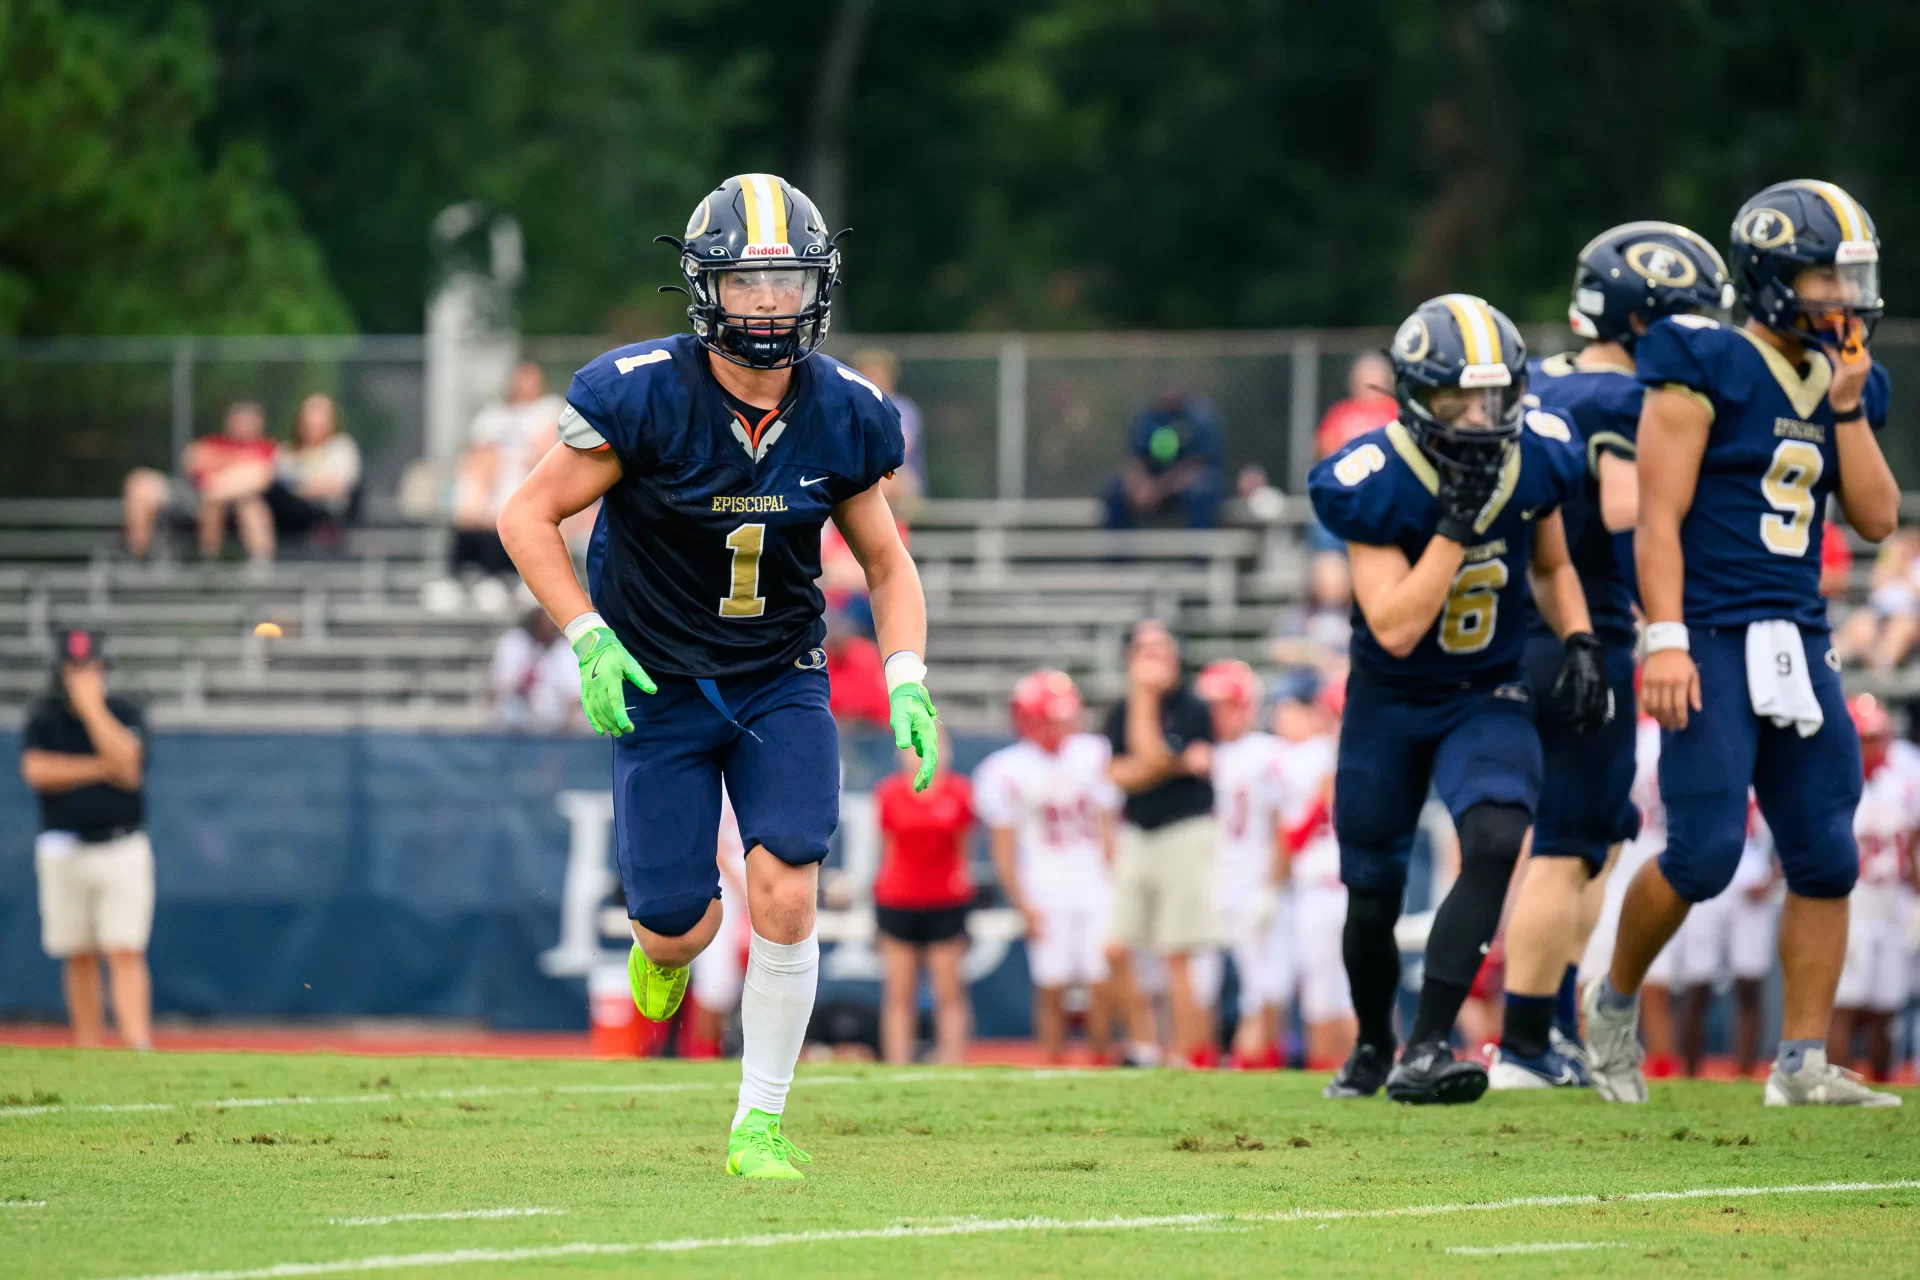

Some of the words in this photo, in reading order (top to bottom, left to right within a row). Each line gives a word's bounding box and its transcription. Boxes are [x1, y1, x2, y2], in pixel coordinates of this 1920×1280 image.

[748, 246, 789, 256] Riddell
[614, 349, 672, 375] 1
[836, 366, 883, 402] 1
[1333, 443, 1386, 486] 6
[712, 495, 788, 513] EPISCOPAL
[1761, 438, 1824, 557] 9
[718, 523, 766, 618] 1
[1437, 557, 1508, 655] 6
[1775, 652, 1792, 677] 9
